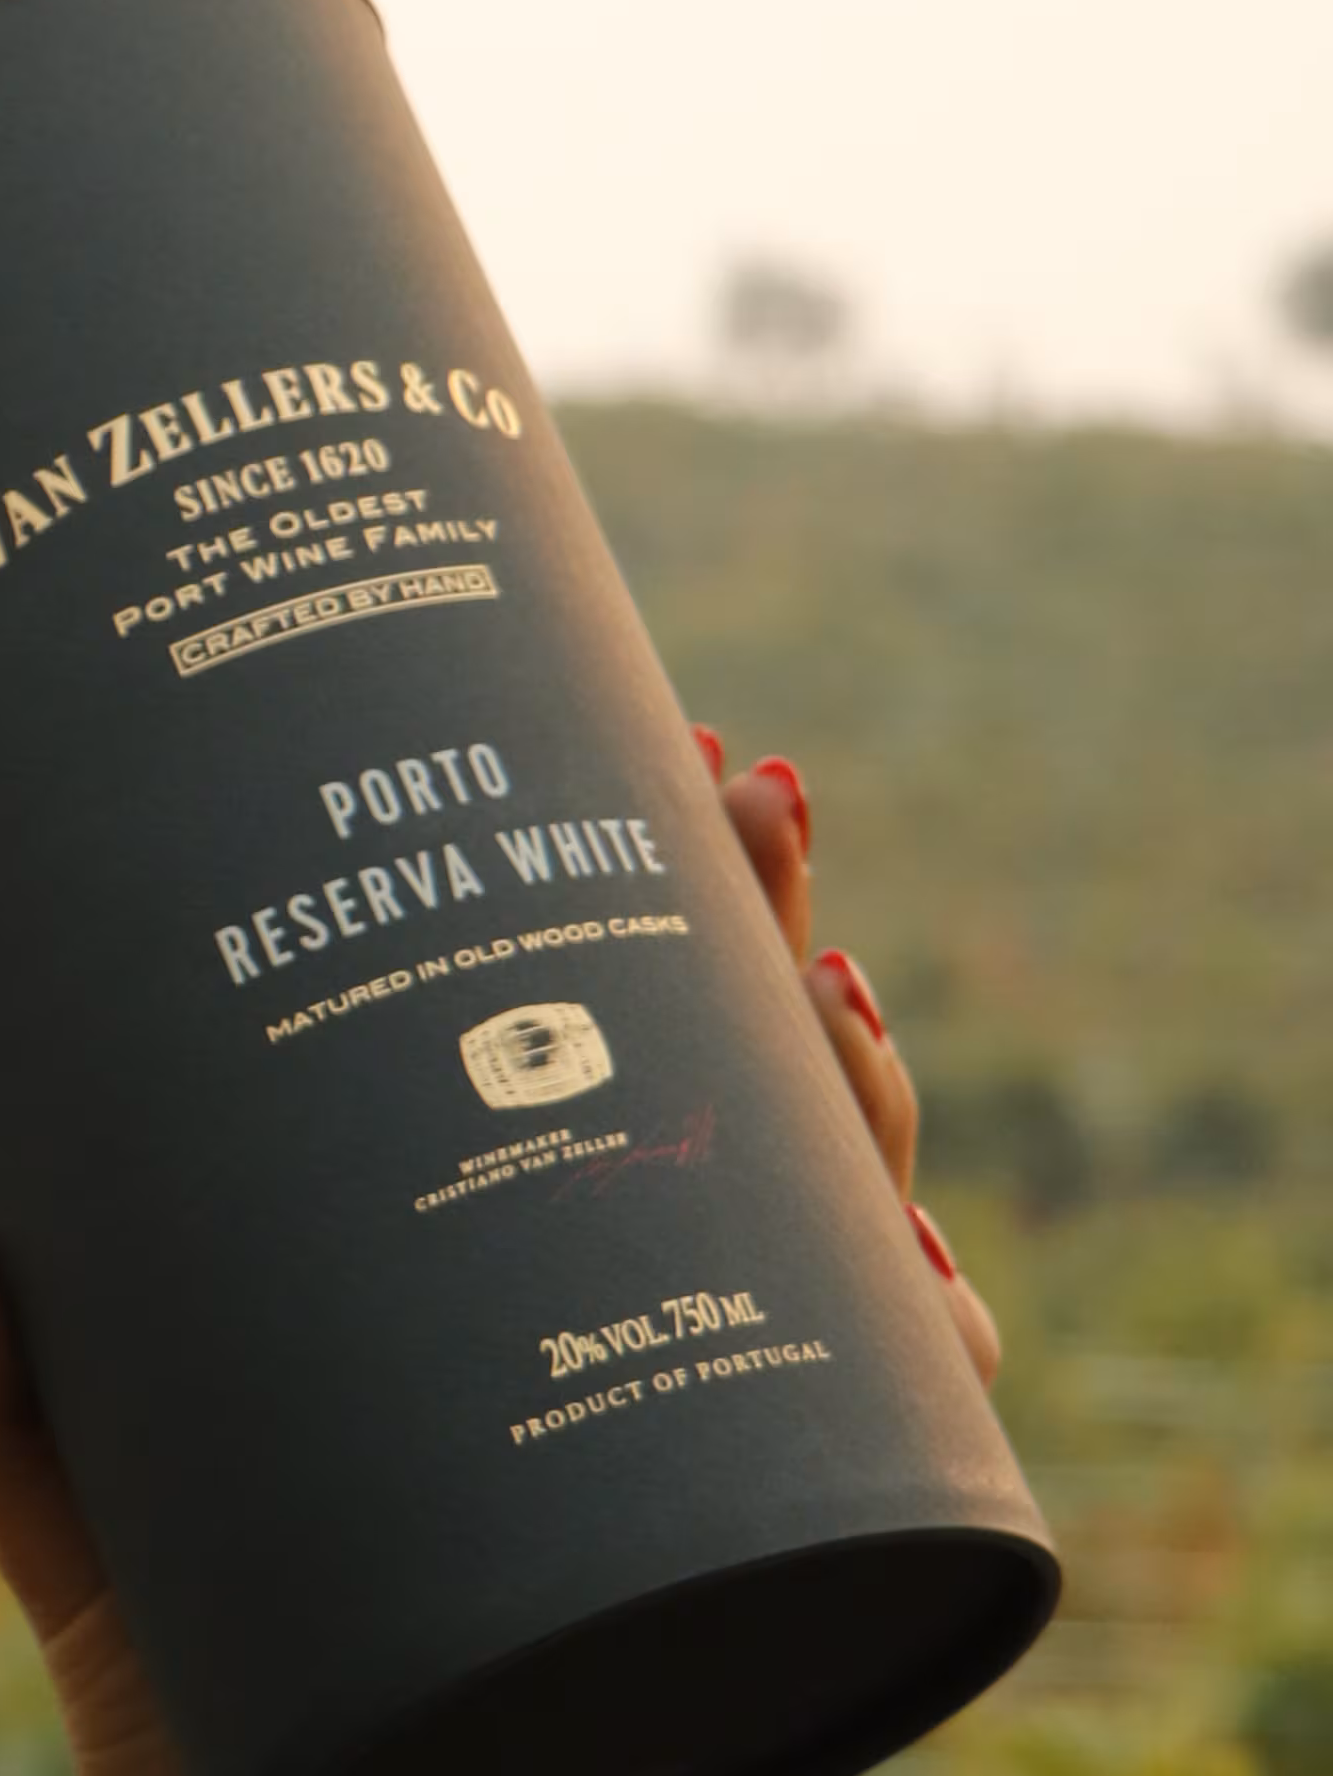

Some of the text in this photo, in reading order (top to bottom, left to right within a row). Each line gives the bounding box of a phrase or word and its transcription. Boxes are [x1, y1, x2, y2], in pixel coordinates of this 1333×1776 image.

[89, 360, 389, 488] ZELLERS
[400, 362, 441, 415] &
[174, 438, 389, 521] SINCE 1620
[113, 520, 498, 637] PORT WINE FAMILY
[166, 489, 428, 572] THE OLDEST
[181, 570, 486, 666] CRAFTED BY HAND
[319, 743, 510, 839] PORTO
[214, 820, 665, 986] RESERVA WHITE
[266, 915, 689, 1044] MATURED IN OLD WOOD CASKS
[414, 1131, 628, 1212] CRISTIANO VAN ZELLER
[459, 1128, 571, 1175] WINEMAKER
[540, 1331, 608, 1378] 20%
[661, 1292, 720, 1338] 750
[510, 1341, 830, 1445] PRODUCT OF PORTUGAL
